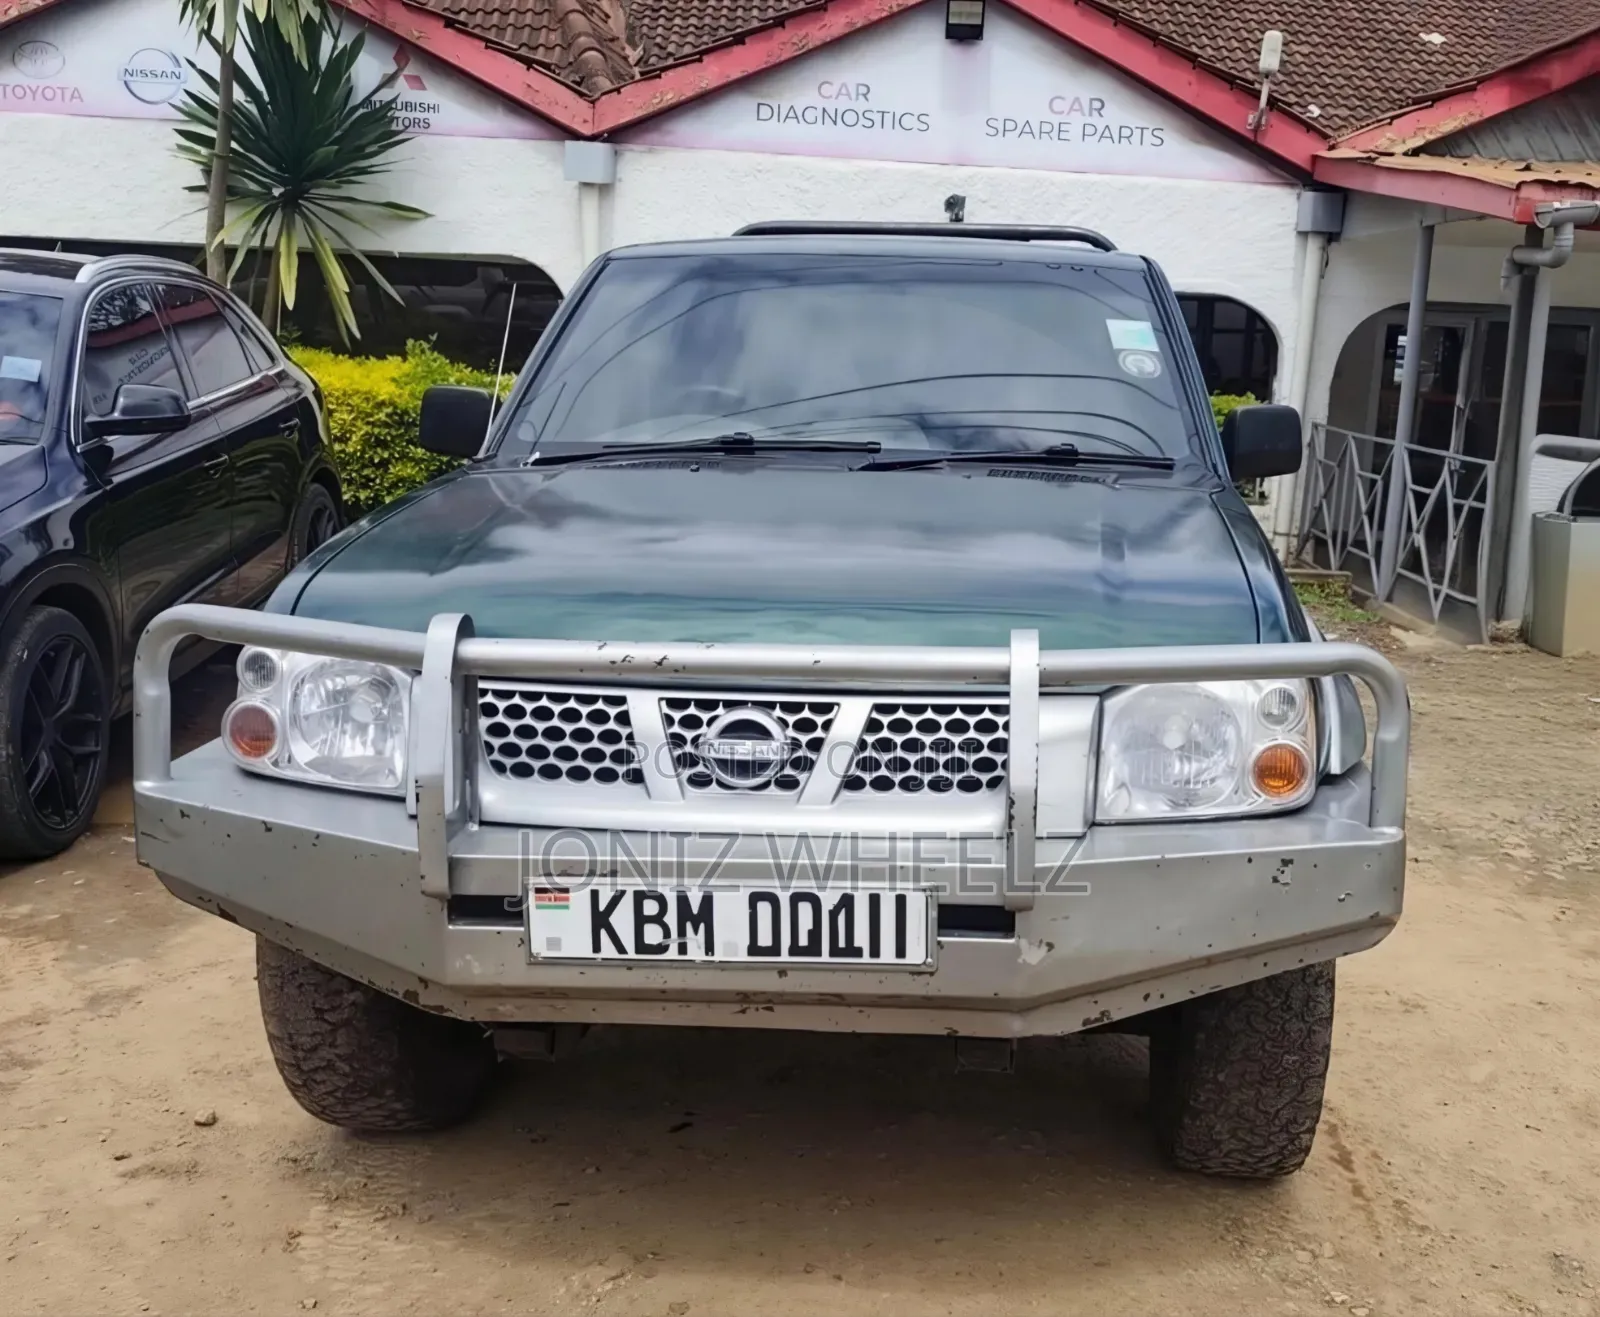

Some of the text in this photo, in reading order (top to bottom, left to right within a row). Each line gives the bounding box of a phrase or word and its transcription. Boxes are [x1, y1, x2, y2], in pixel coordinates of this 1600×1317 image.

[123, 67, 182, 80] NISSAN
[0, 84, 84, 103] TOYOTA
[818, 80, 871, 102] CAR
[756, 102, 930, 132] DIAGNOSTICS
[1049, 96, 1105, 118] CAR
[393, 116, 431, 129] TORS
[985, 117, 1165, 147] SPARE PARTS
[590, 888, 715, 956] KBM
